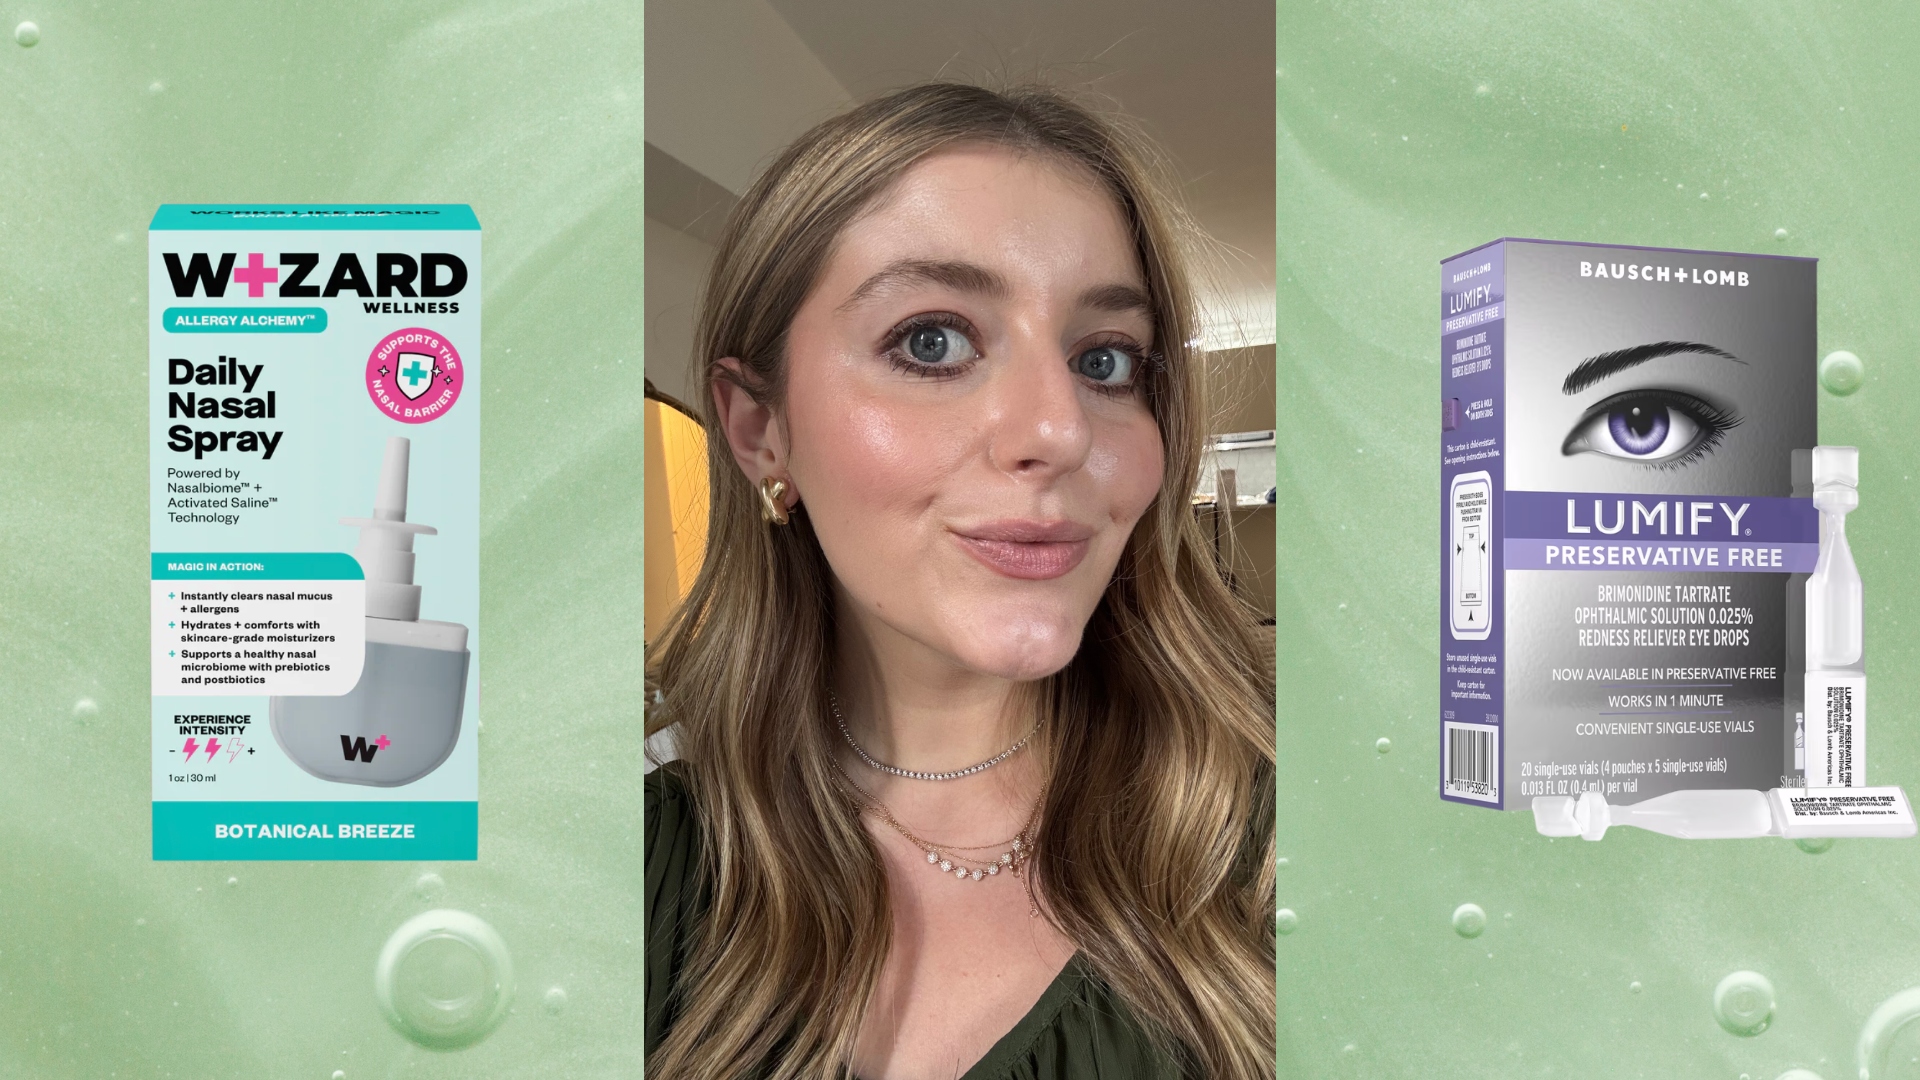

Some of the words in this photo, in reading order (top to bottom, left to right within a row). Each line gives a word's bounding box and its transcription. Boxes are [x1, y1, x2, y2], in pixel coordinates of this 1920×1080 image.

[363, 302, 460, 313] WELLNESS
[175, 315, 238, 326] ALLERGY
[1446, 310, 1484, 332] PRESERVATIVE
[1485, 306, 1499, 321] FREE
[378, 334, 439, 361] SUPPORTS
[439, 345, 456, 370] THE
[168, 355, 264, 393] Daily
[373, 379, 401, 415] NASAL
[404, 389, 453, 417] BARRIER
[168, 391, 275, 419] Nasal
[167, 424, 283, 459] Spray
[167, 467, 222, 478] Powered
[225, 467, 240, 480] by
[167, 497, 228, 508] Activated
[167, 512, 240, 525] Technology
[1546, 545, 1719, 566] PRESERVATIVE
[1728, 547, 1783, 567] FREE
[168, 563, 204, 571] MAGIC
[206, 563, 217, 571] IN
[219, 563, 264, 571] ACTION:
[181, 591, 228, 602] Instantly
[231, 591, 263, 601] clears
[266, 591, 294, 601] nasal
[297, 593, 333, 601] mucus
[1598, 585, 1672, 603] BRIMONIDINE
[1675, 585, 1731, 603] TARTRATE
[190, 604, 239, 615] allergens
[1574, 607, 1647, 625] OPHTHALMIC
[1650, 607, 1705, 625] SOLUTION
[1708, 607, 1754, 625] 0.025%
[181, 620, 231, 631] Hydrates
[244, 620, 294, 629] comforts
[296, 620, 320, 629] with
[181, 633, 264, 644] skincare-grade
[267, 633, 336, 643] moisturizers
[1579, 629, 1630, 647] REDNESS
[1633, 629, 1686, 647] RELIEVER
[1689, 629, 1710, 647] EYE
[1713, 629, 1750, 647] DROPS
[181, 649, 232, 660] Supports
[244, 649, 284, 660] healthy
[287, 649, 316, 658] nasal
[181, 662, 246, 671] microbiome
[249, 662, 272, 671] with
[275, 662, 330, 673] prebiotics
[1552, 668, 1584, 681] NOW
[1586, 668, 1648, 681] AVAILABLE
[1652, 668, 1664, 680] IN
[1666, 667, 1747, 680] PRESERVATIVE
[1749, 667, 1777, 679] FREE
[181, 675, 201, 684] and
[204, 675, 266, 686] postbiotics
[1608, 695, 1652, 707] WORKS
[1655, 695, 1667, 707] IN
[1670, 695, 1675, 707] 1
[1680, 694, 1724, 707] MINUTE
[174, 715, 251, 724] EXPERIENCE
[179, 726, 246, 735] INTENSITY
[1576, 722, 1654, 736] CONVENIENT
[1656, 721, 1721, 734] SINGLE-USE
[1723, 720, 1755, 733] VIALS
[1521, 762, 1532, 777] 20
[1534, 761, 1577, 779] single-use
[1579, 760, 1599, 775] vials
[1601, 760, 1610, 776] (4
[1611, 759, 1645, 777] pouches
[1647, 763, 1653, 773] x
[1654, 759, 1660, 773] 5
[1662, 758, 1703, 776] single-use
[1705, 757, 1728, 773] vials)
[168, 774, 173, 782] 1
[190, 774, 204, 782] 30
[205, 773, 216, 782] ml
[1521, 780, 1544, 796] 0.013
[1546, 780, 1555, 795] FL
[1557, 780, 1568, 795] OZ
[1607, 780, 1621, 796] per
[1623, 778, 1638, 793] vial
[215, 824, 333, 839] BOTANICAL
[338, 824, 415, 838] BREEZE
